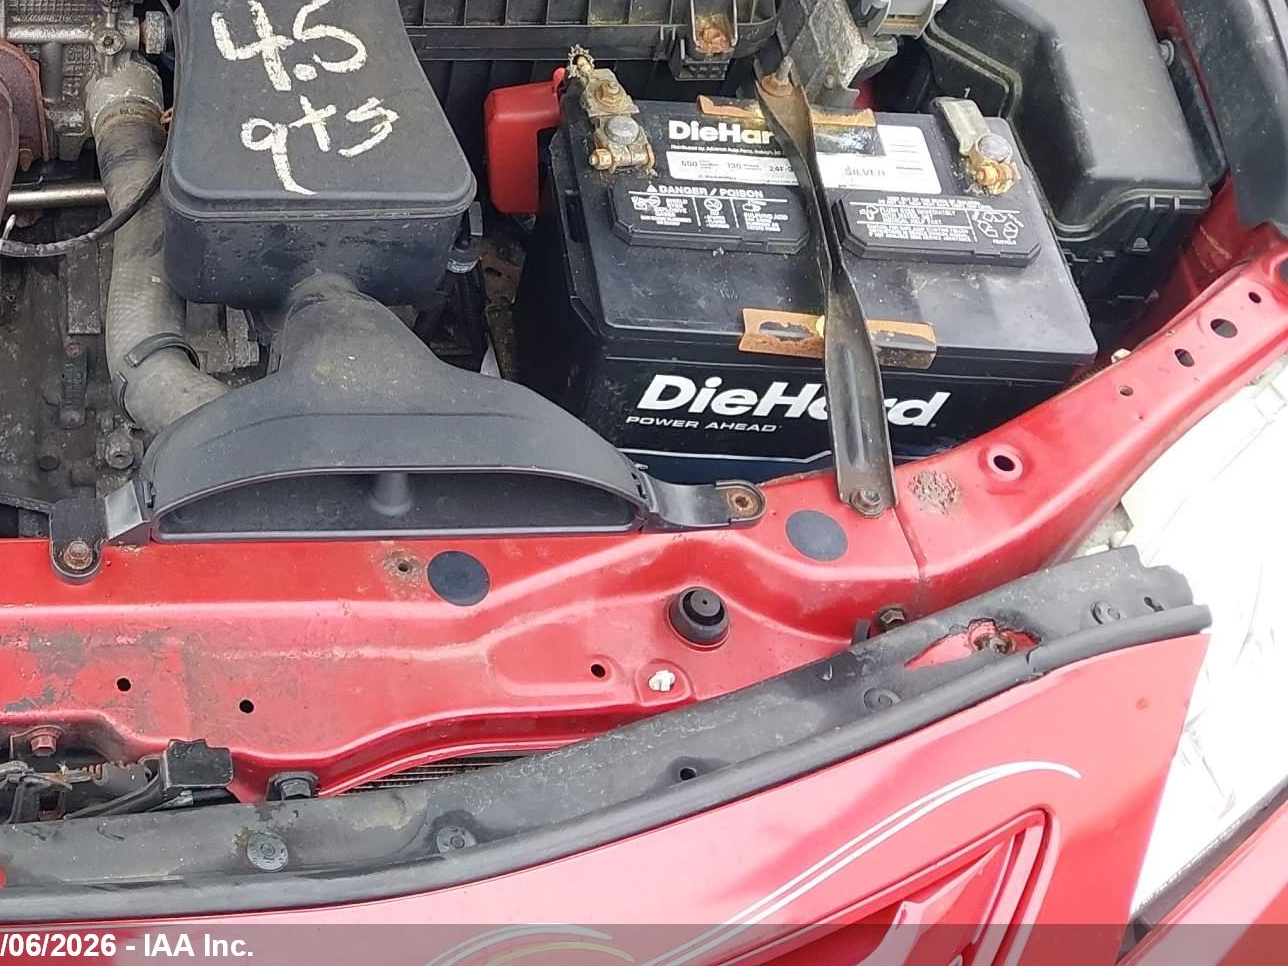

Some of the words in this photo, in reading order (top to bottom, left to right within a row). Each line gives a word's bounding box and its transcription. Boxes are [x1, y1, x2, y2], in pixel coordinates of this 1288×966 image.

[669, 120, 774, 145] DieHar
[240, 94, 400, 196] qts
[658, 185, 708, 196] DANGER
[719, 188, 764, 199] POISON
[625, 416, 699, 429] POWER
[704, 422, 779, 433] AHEAD
